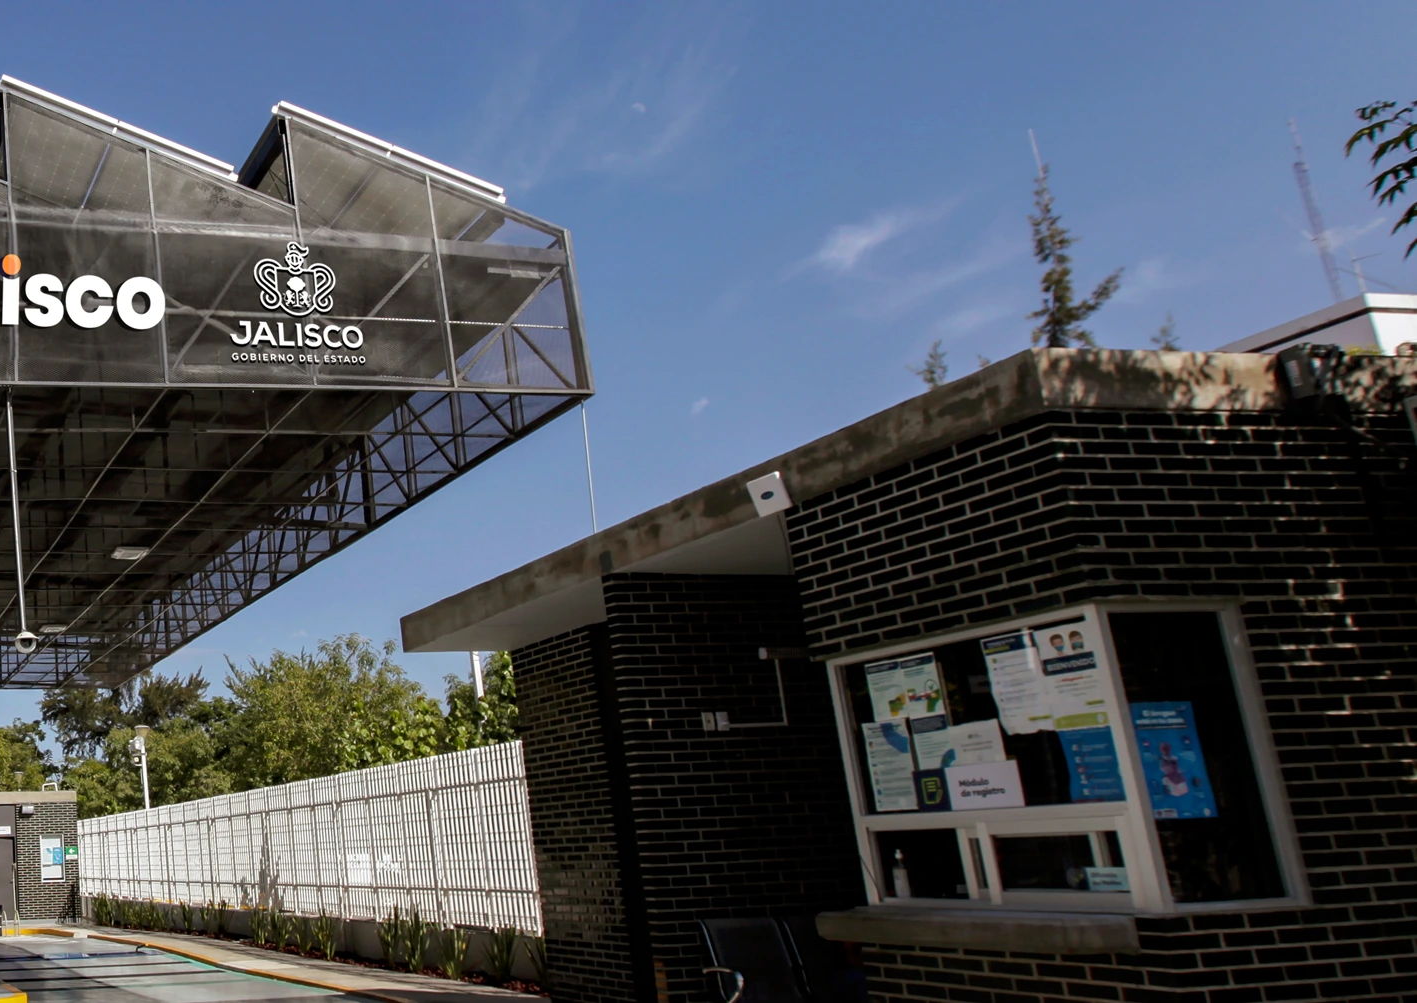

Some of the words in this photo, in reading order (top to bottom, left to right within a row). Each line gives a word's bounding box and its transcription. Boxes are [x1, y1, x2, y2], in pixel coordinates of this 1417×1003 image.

[230, 320, 364, 349] JALISCO
[231, 352, 295, 363] GOBIERNO
[299, 354, 320, 363] DEL
[323, 354, 366, 364] ESTADO
[958, 777, 990, 787] Módulo
[961, 789, 971, 797] de
[972, 787, 1006, 797] registro
